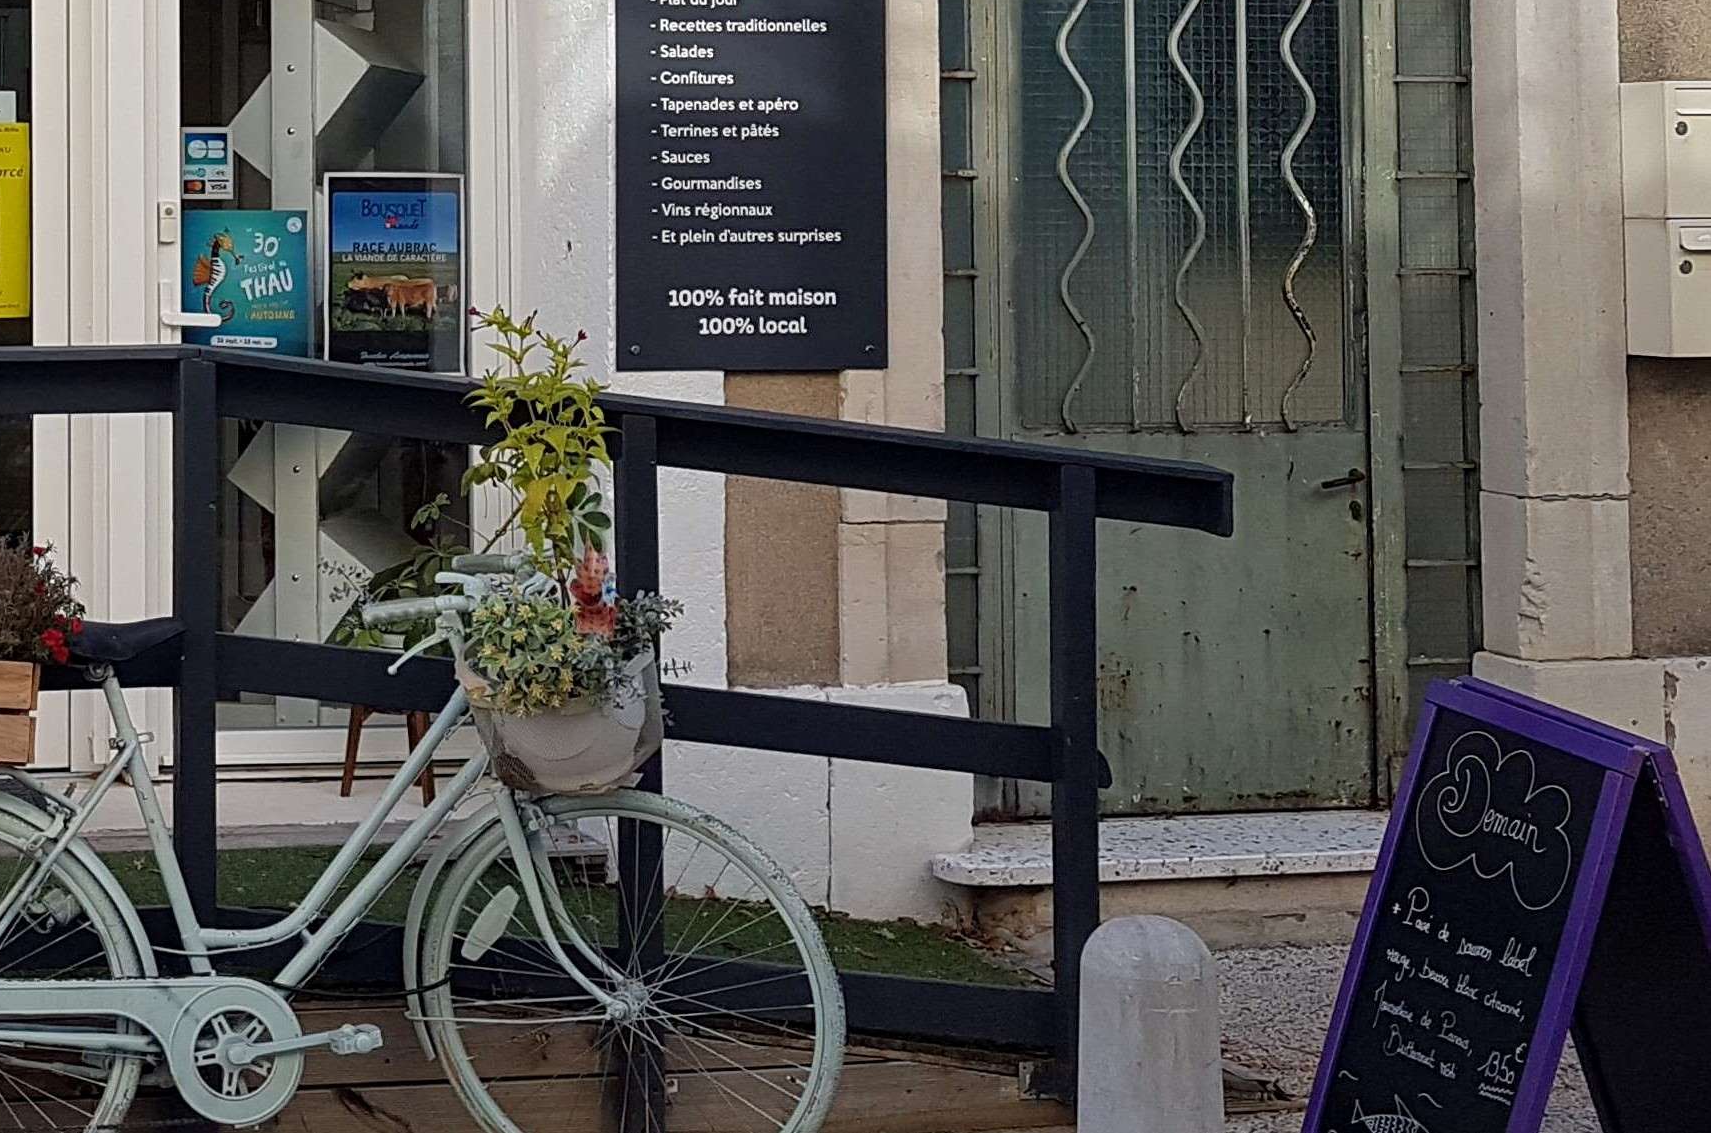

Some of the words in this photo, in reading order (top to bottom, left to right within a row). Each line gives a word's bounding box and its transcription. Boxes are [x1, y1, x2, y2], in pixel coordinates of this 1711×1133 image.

[659, 18, 723, 32] Recettes
[725, 18, 827, 33] traditionnelles
[660, 44, 714, 59] Salades
[659, 70, 734, 85] Confitures
[659, 97, 736, 114] Tapenades
[738, 99, 754, 111] et
[757, 96, 799, 114] apéro
[660, 123, 719, 138] Terrines
[722, 125, 738, 137] et
[740, 123, 780, 141] pâtés
[661, 150, 711, 164] Sauces
[661, 176, 762, 190] Gourmandises
[661, 203, 692, 217] Vins
[694, 202, 773, 220] régionnaux
[661, 229, 677, 244] Et
[679, 229, 715, 246] plein
[718, 228, 775, 243] d'autres
[777, 228, 842, 245] surprises
[352, 242, 385, 254] RACE
[388, 242, 437, 254] AUBRAC
[341, 253, 354, 262] LA
[355, 253, 384, 262] VIANDE
[388, 253, 399, 262] DE
[240, 267, 294, 301] THAU
[668, 289, 725, 307] 100%
[727, 287, 765, 306] fait
[768, 287, 837, 306] maison
[699, 317, 755, 335] 100%
[759, 316, 808, 334] local
[1435, 754, 1547, 853] Demain
[1438, 922, 1450, 943] de
